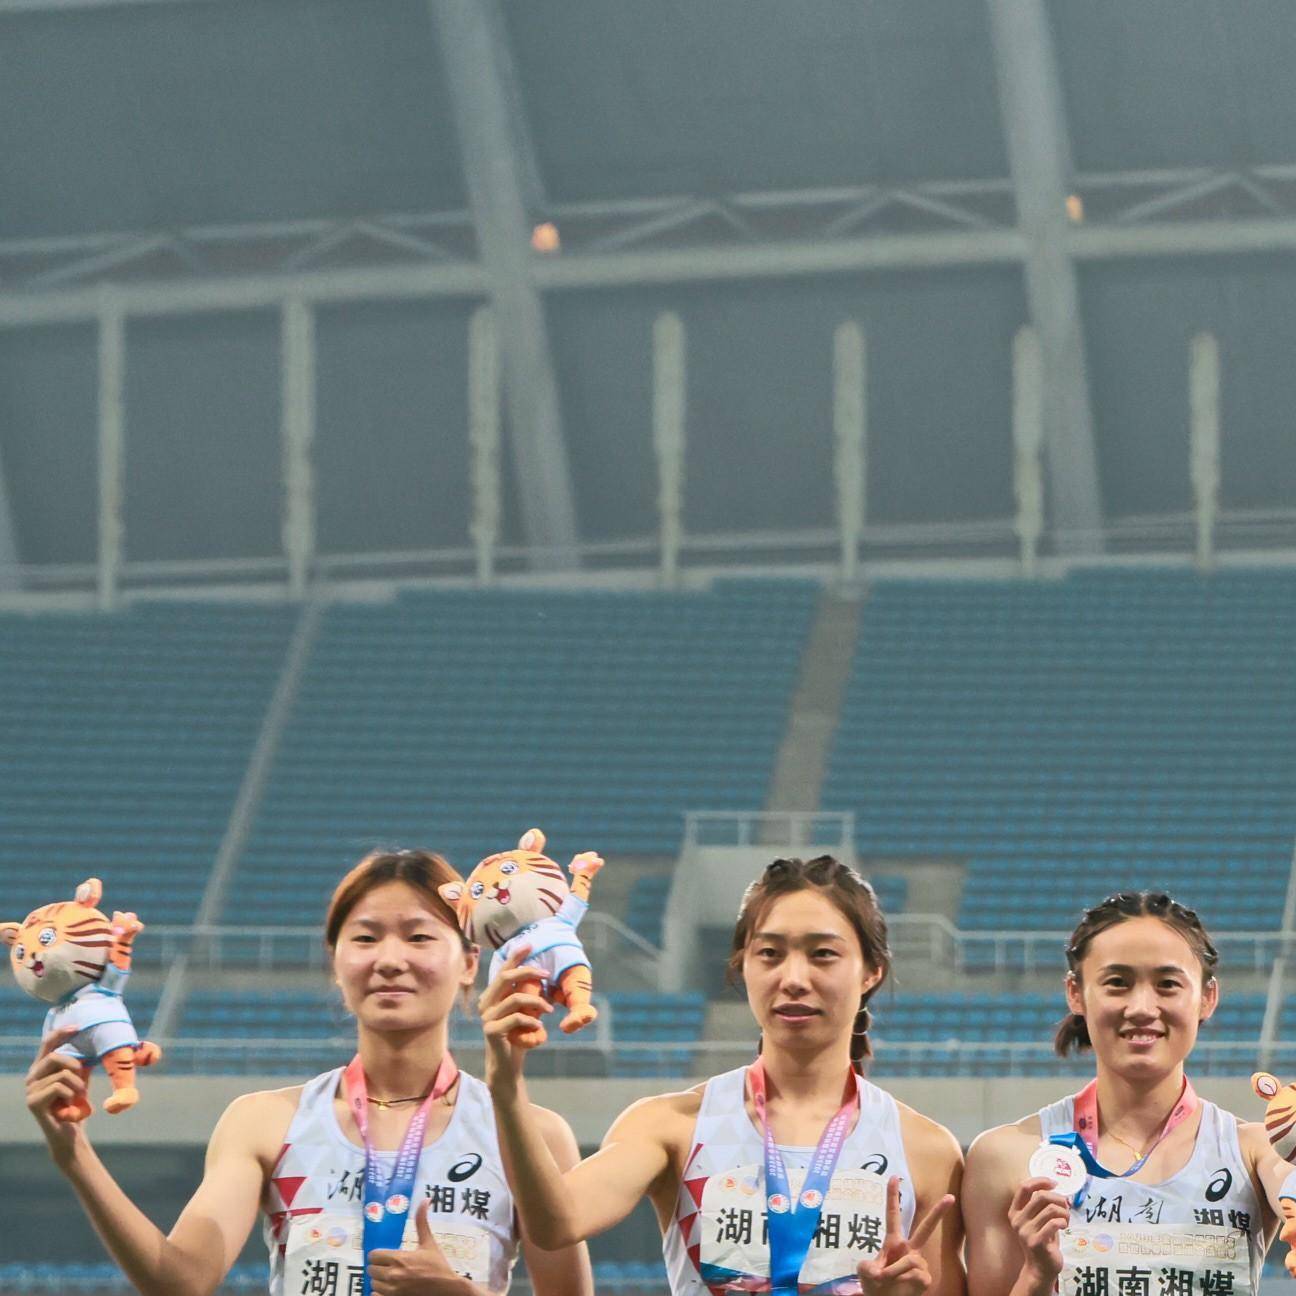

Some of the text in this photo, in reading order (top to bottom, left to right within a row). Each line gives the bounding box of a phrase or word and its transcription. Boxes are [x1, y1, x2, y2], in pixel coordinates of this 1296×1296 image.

[424, 1184, 492, 1220] 湘煤
[715, 1207, 883, 1254] 湖湘煤
